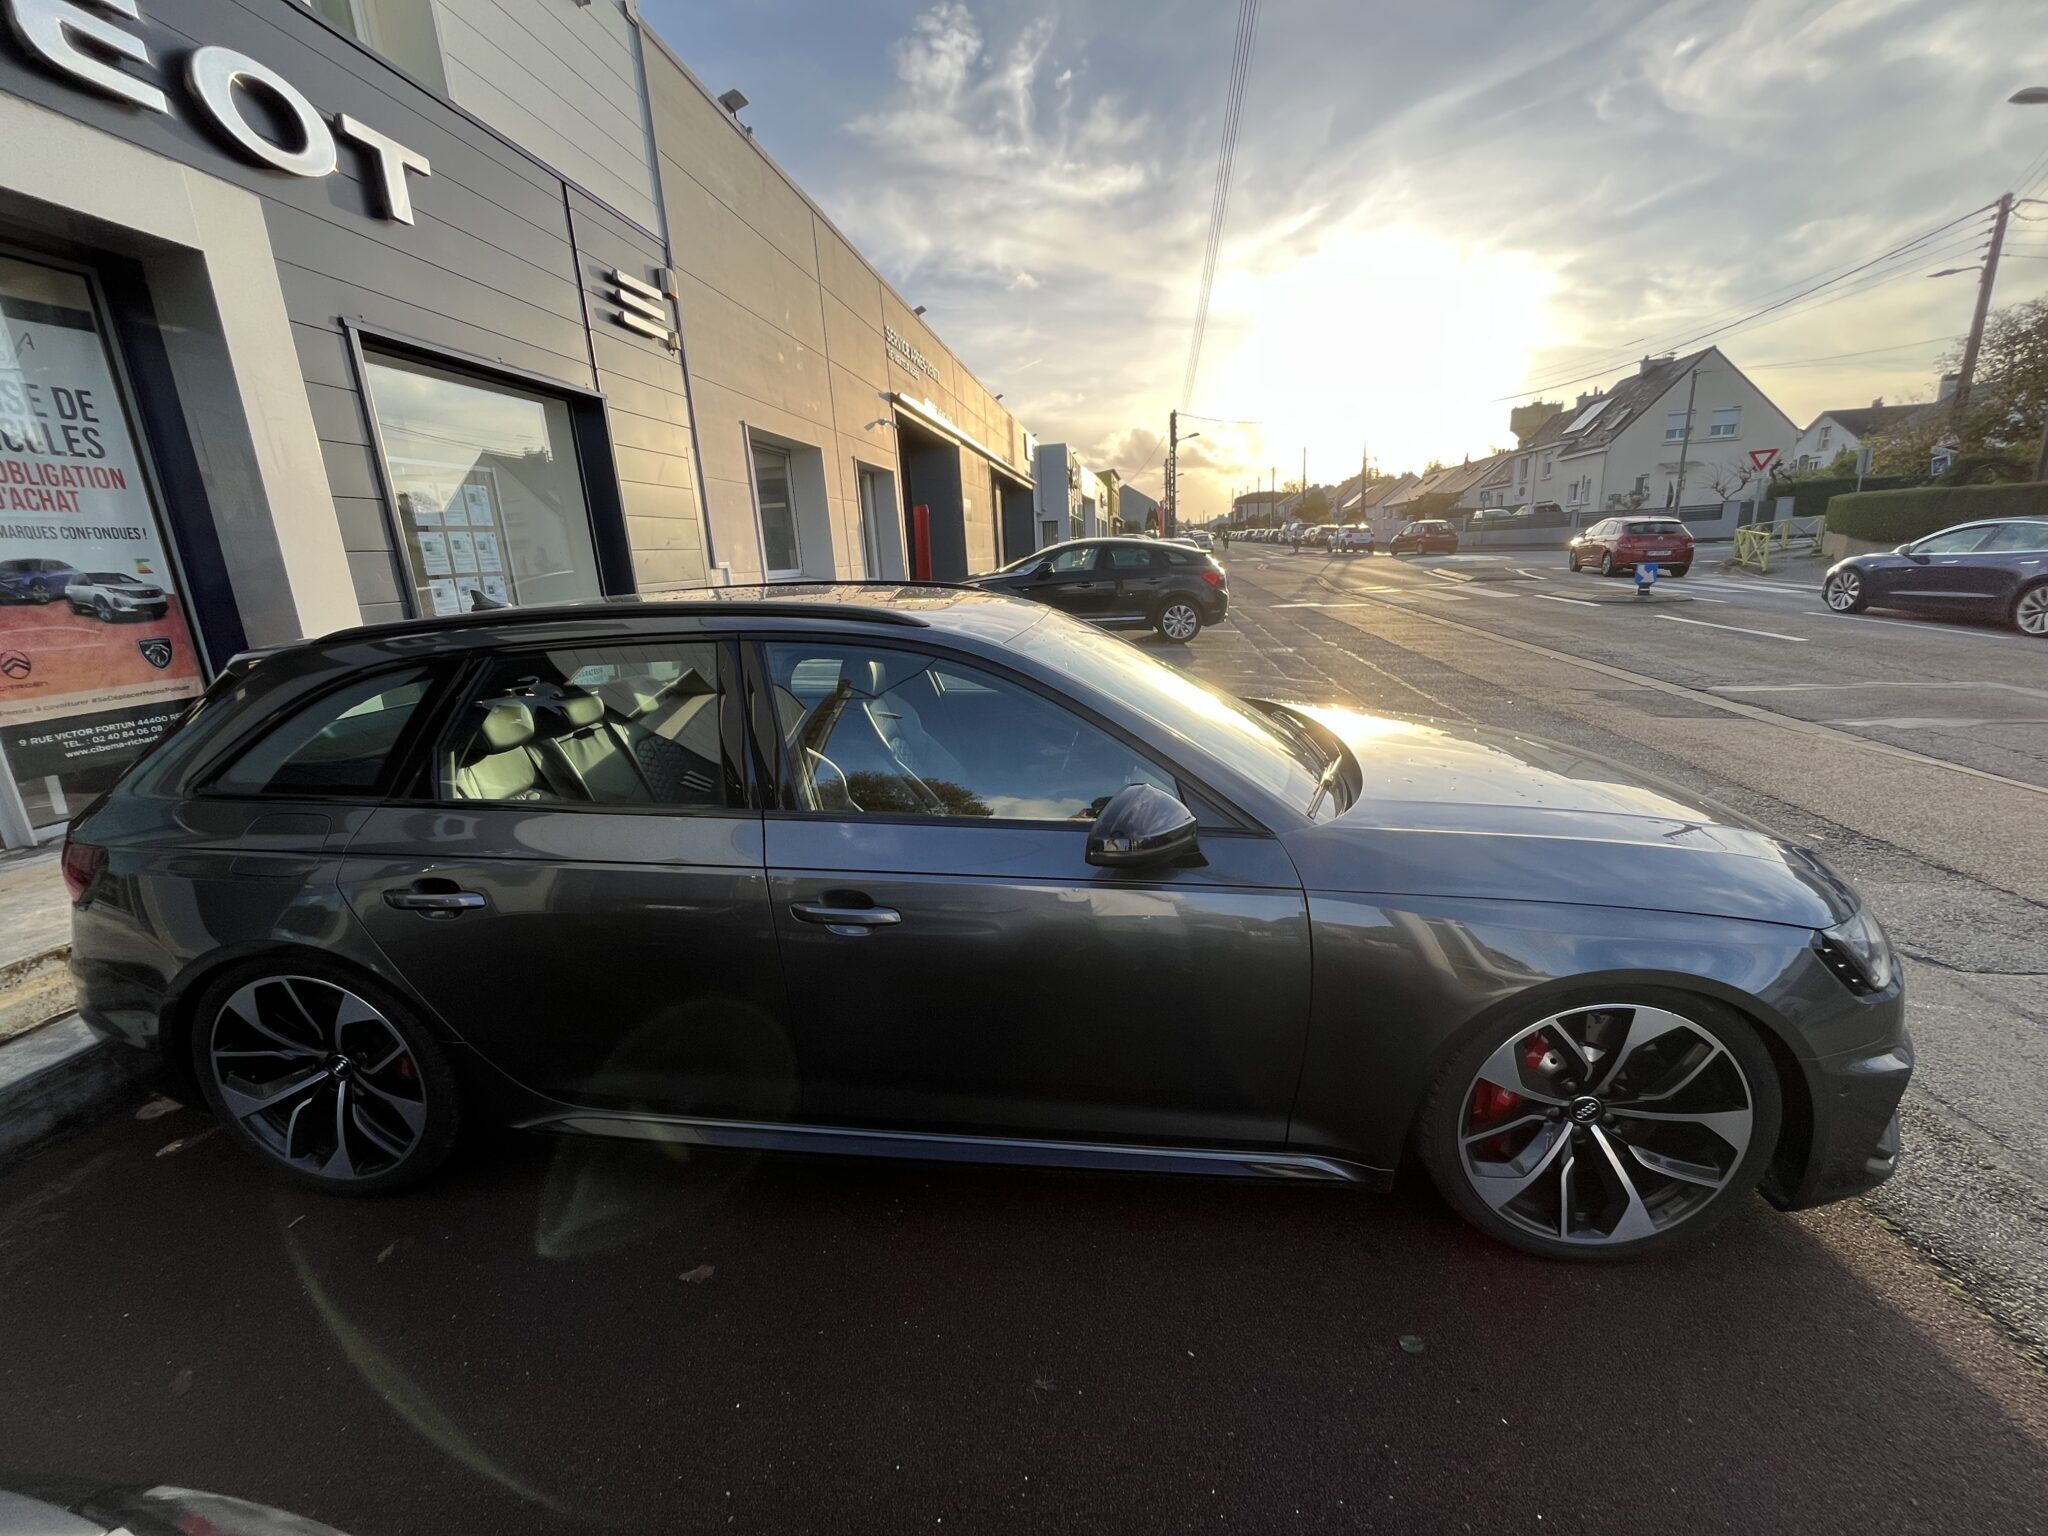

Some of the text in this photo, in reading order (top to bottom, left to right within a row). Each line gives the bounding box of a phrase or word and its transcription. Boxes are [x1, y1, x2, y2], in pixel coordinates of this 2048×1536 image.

[50, 386, 99, 423] DE
[60, 526, 141, 540] CONFONDUES
[18, 739, 27, 747] 9
[30, 735, 54, 745] RUE
[54, 728, 94, 741] VICTOR
[95, 720, 136, 734] FORTUN
[137, 715, 168, 727] 44400
[92, 735, 106, 744] 02
[107, 732, 121, 741] 40
[121, 730, 135, 739] 84
[136, 727, 149, 736] 06
